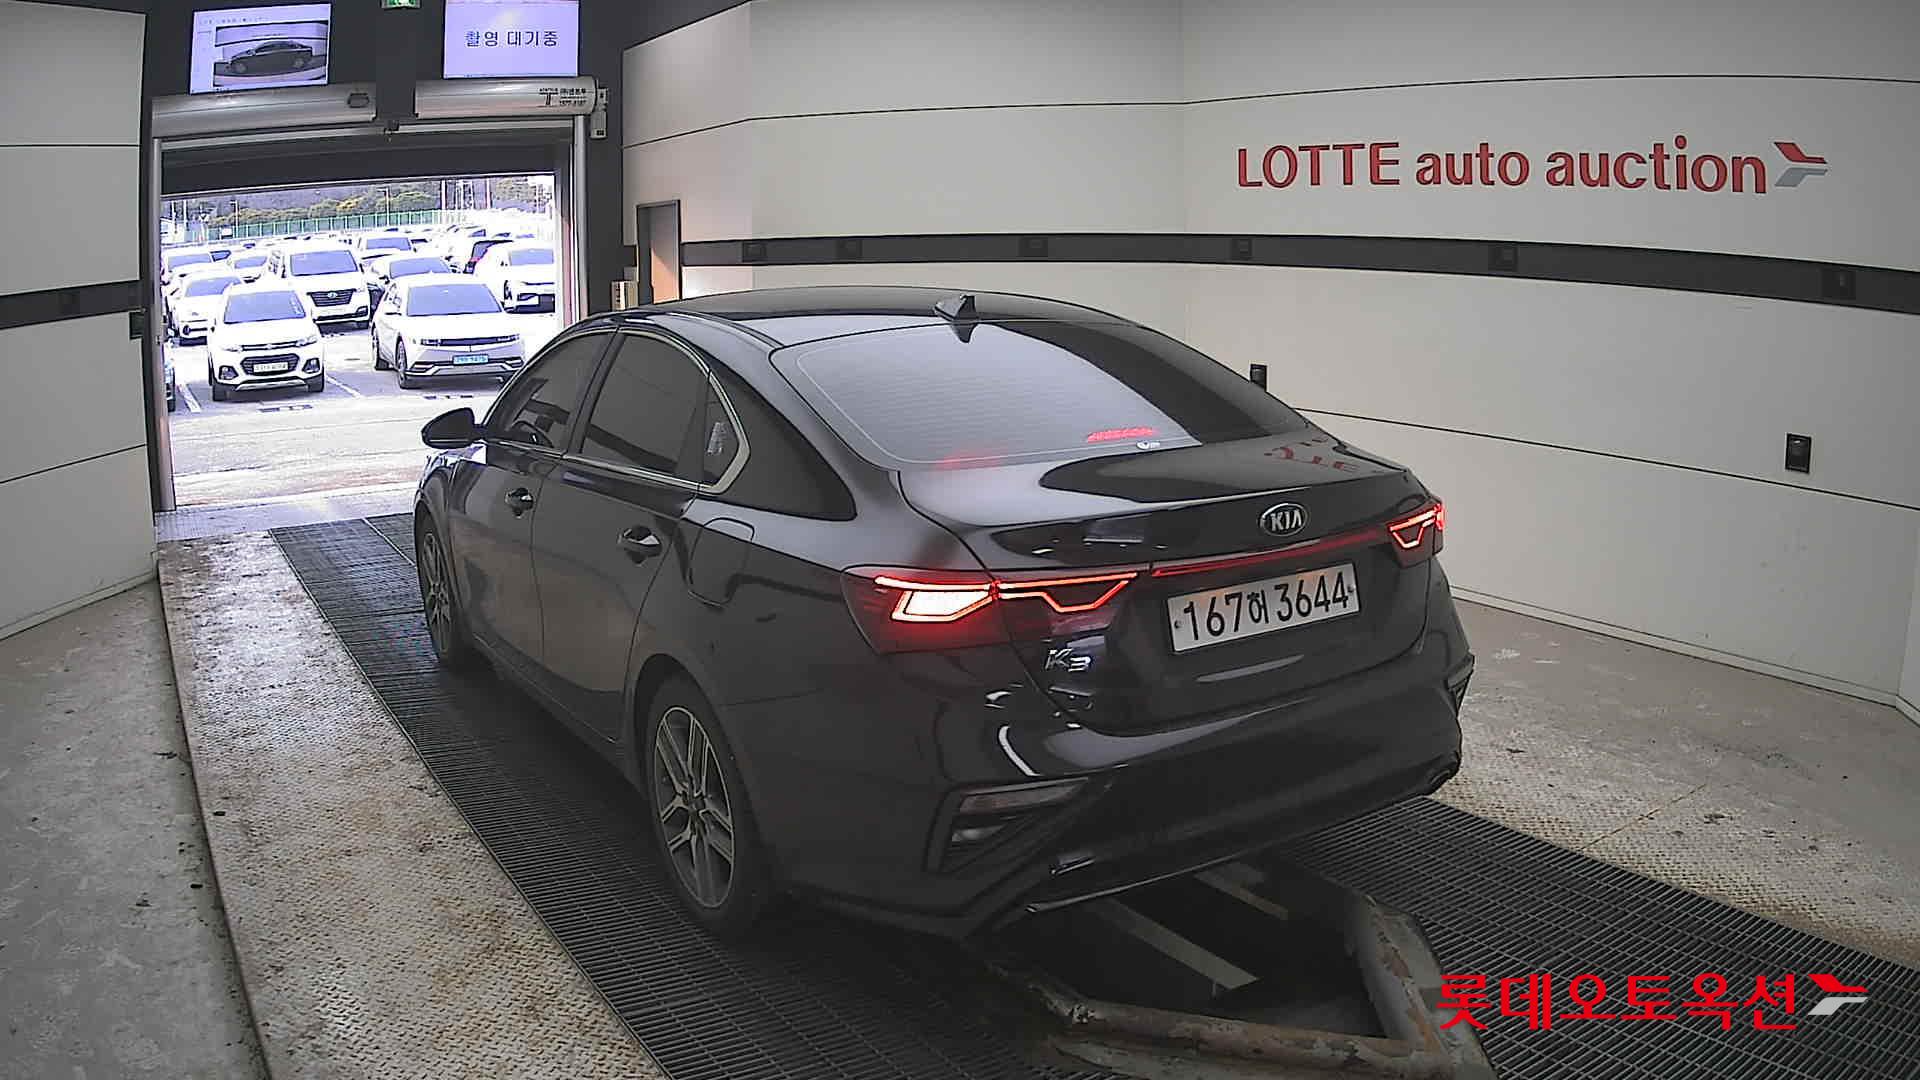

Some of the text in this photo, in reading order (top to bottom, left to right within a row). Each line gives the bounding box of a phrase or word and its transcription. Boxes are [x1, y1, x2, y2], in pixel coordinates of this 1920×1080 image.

[464, 31, 558, 47] 촬영 대기중
[1237, 134, 1767, 194] LOTTE auto auction
[1270, 509, 1302, 531] KIA
[1044, 648, 1092, 672] K3
